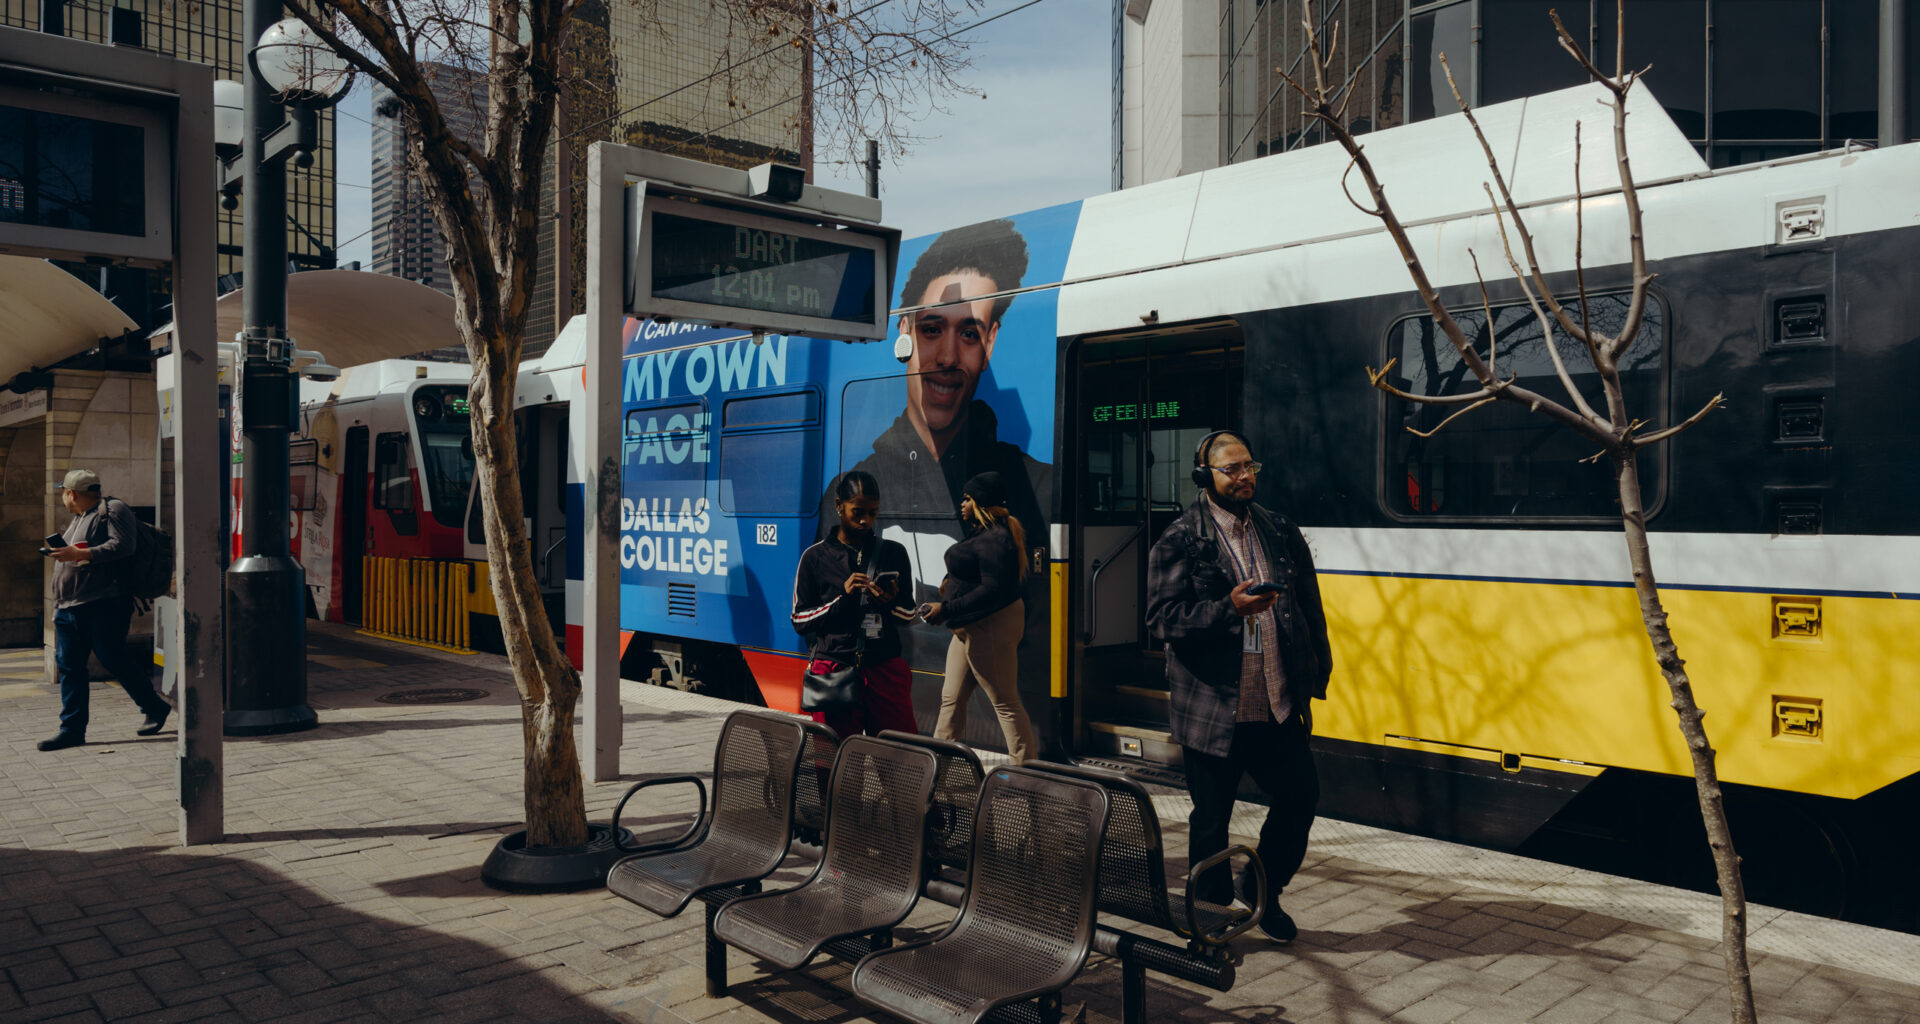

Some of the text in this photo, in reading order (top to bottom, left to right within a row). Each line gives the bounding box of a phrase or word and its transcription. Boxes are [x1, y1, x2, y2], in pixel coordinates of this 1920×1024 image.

[736, 227, 799, 267] DART
[711, 264, 820, 309] 12:01 pm
[643, 320, 679, 341] CAN
[623, 335, 788, 402] MY OWN
[622, 412, 712, 465] PACE
[620, 497, 710, 534] DALLAS
[758, 525, 776, 543] 182
[620, 534, 728, 577] COLLEGE
